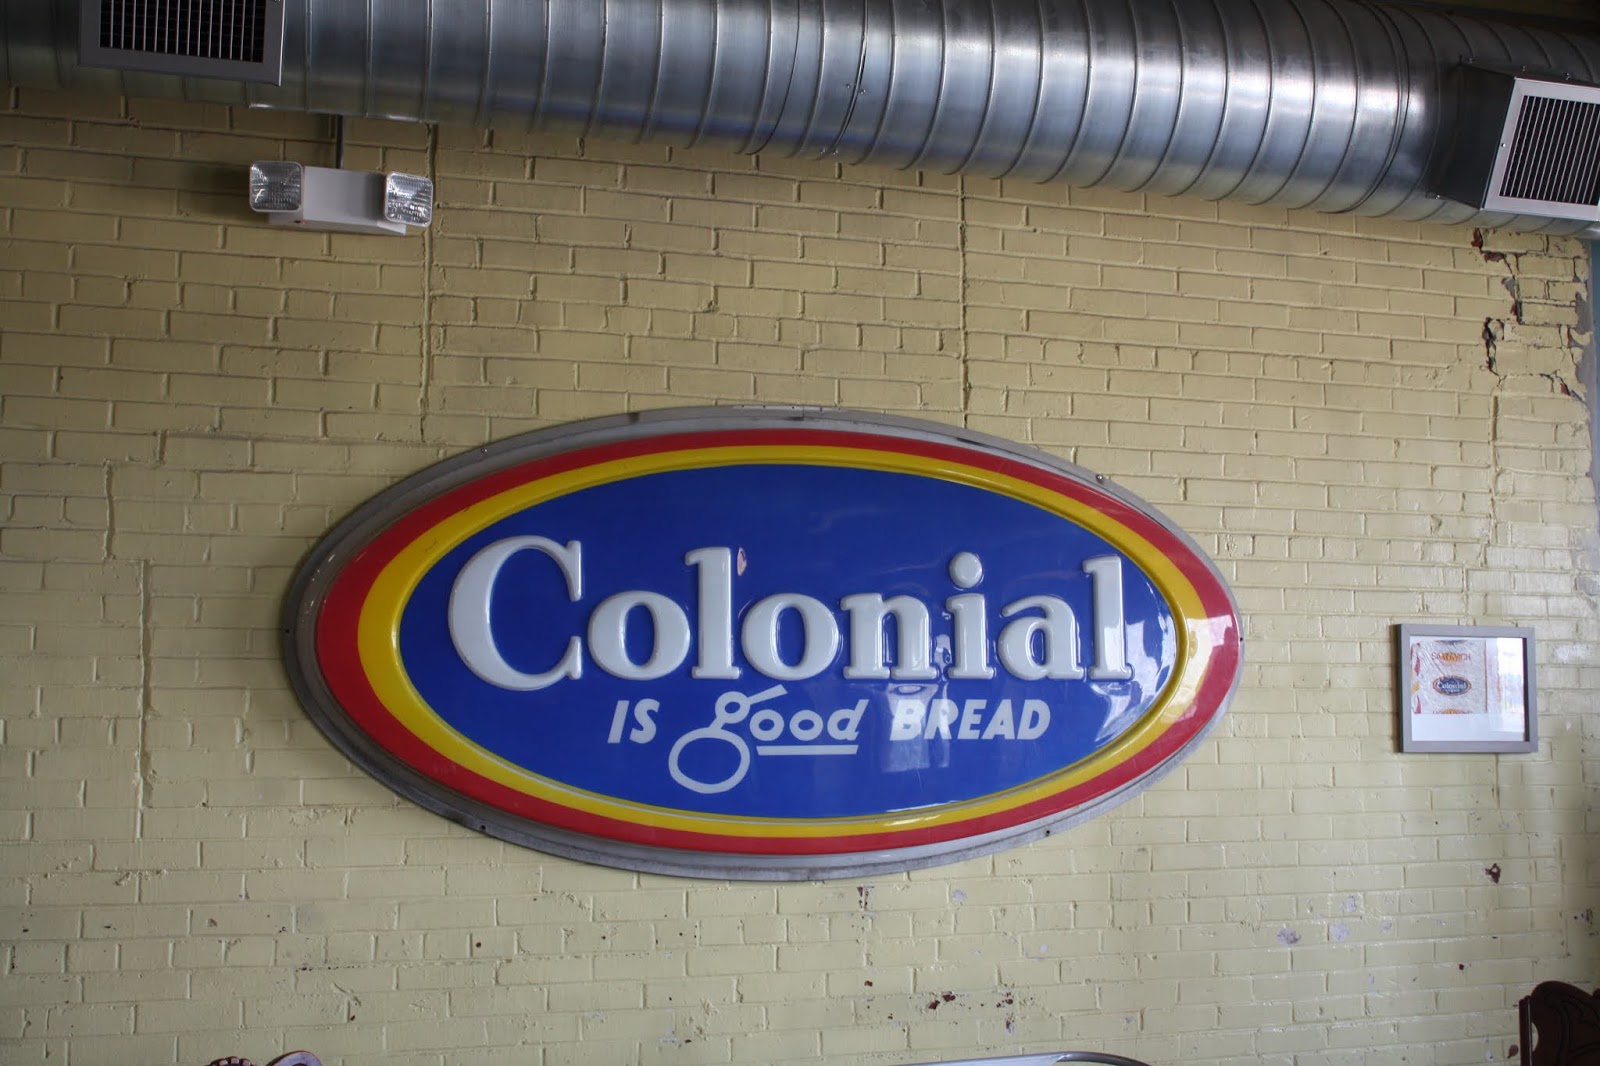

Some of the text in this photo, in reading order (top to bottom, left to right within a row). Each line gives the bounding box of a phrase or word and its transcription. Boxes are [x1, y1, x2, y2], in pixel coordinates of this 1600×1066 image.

[448, 535, 1133, 691] Colonial
[607, 684, 1050, 794] IS good BREAD
[1437, 680, 1467, 689] Colonial
